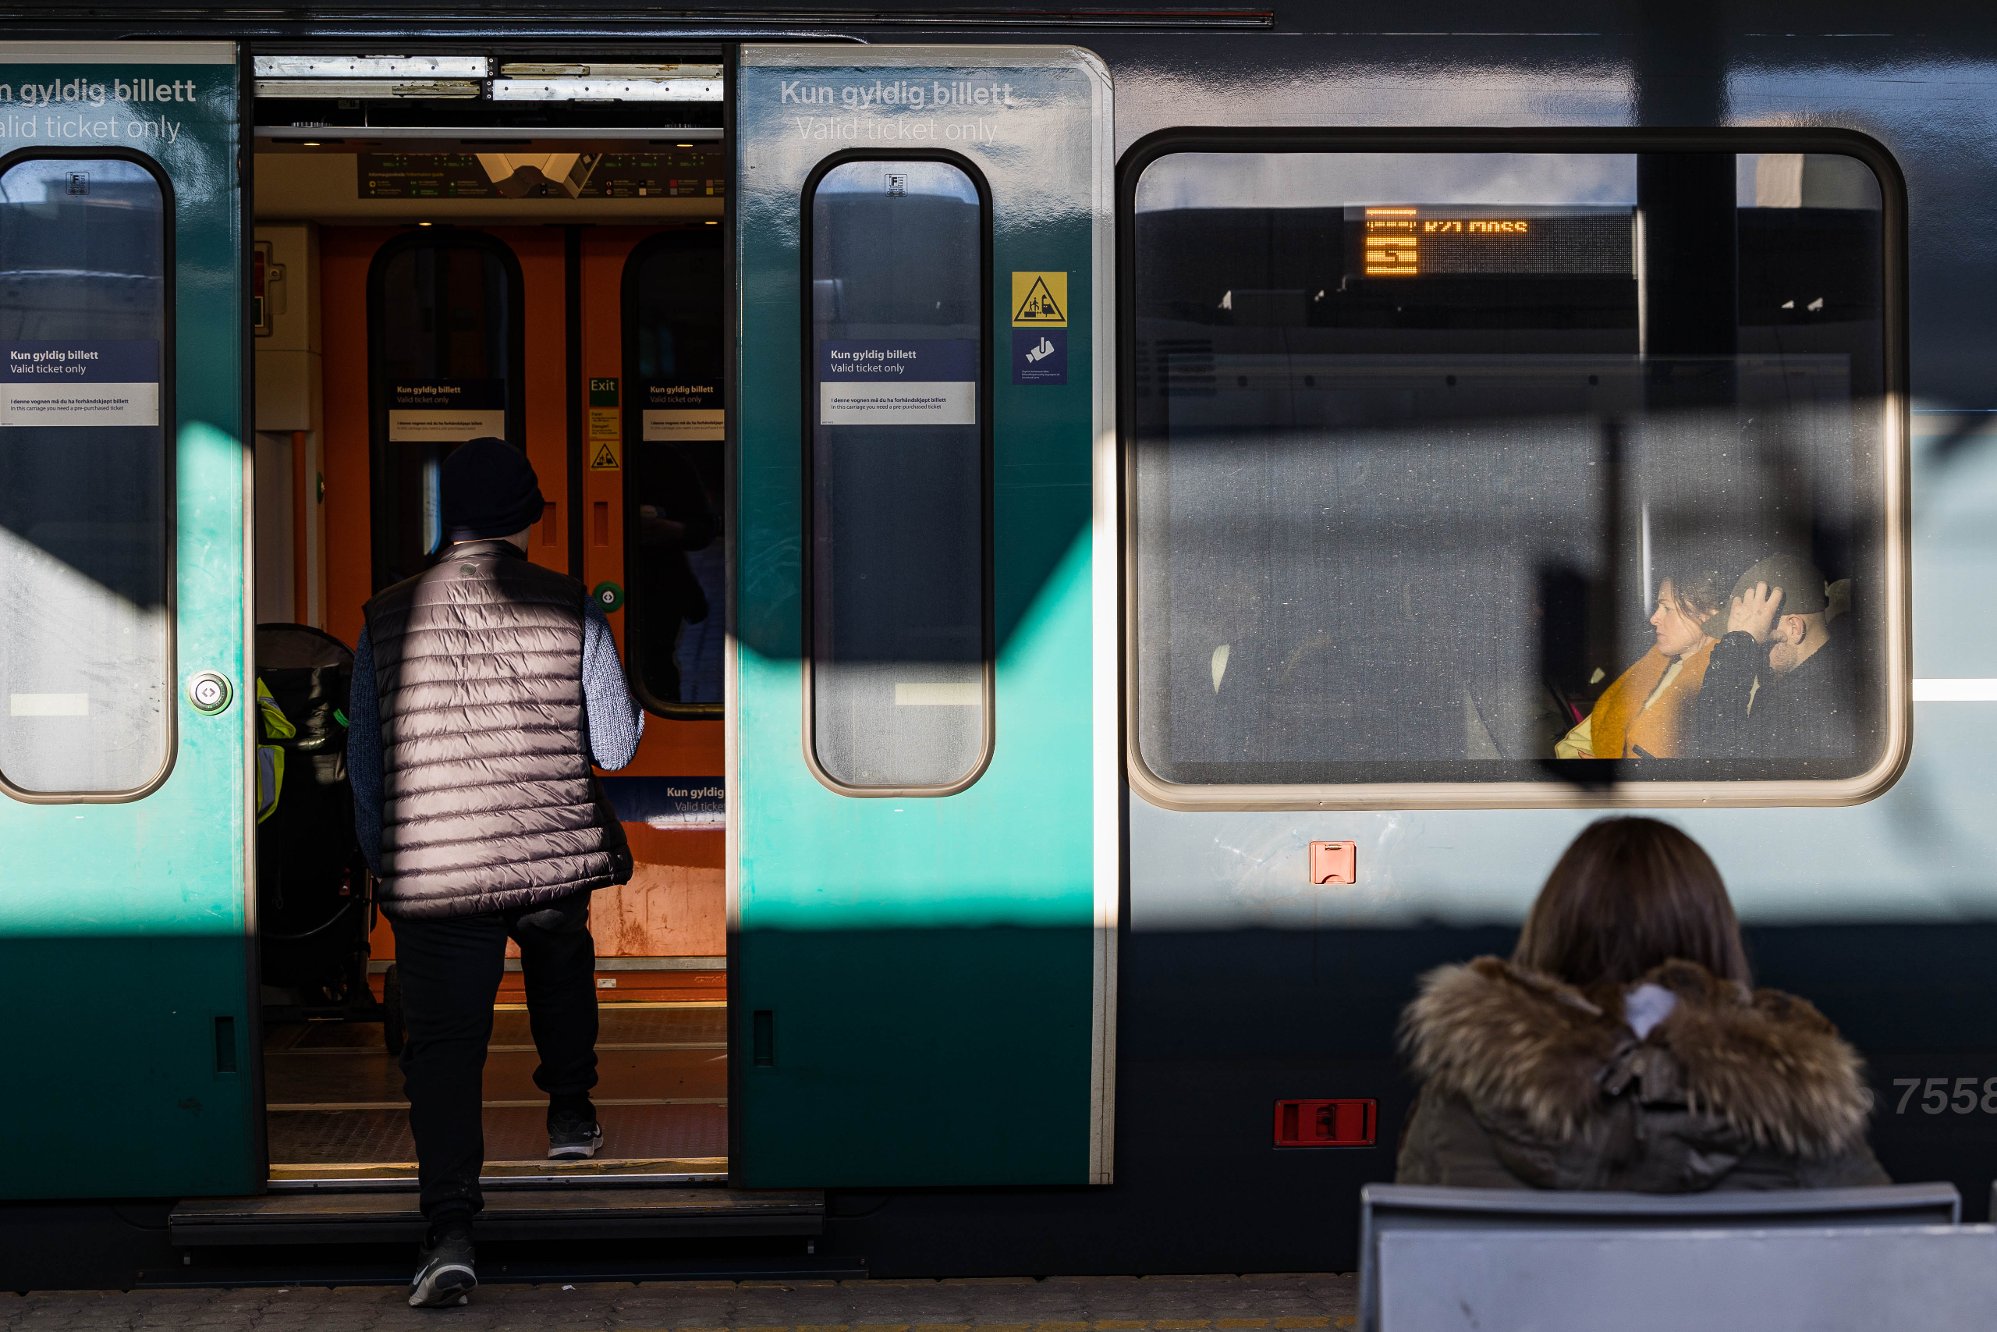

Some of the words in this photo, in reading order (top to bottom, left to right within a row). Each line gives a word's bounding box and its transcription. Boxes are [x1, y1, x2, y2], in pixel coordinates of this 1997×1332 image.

[20, 78, 105, 108] gyldig
[114, 78, 197, 102] billett
[781, 80, 833, 104] Kun
[842, 80, 925, 110] gyldig
[933, 81, 1013, 105] billett
[45, 115, 119, 138] ticket
[127, 115, 181, 144] only
[797, 116, 857, 140] Valid
[867, 116, 938, 140] ticket
[945, 116, 998, 146] only
[10, 350, 31, 360] Kun
[33, 350, 66, 362] gyldig
[67, 350, 99, 360] billett
[831, 350, 851, 359] Kun
[852, 350, 885, 361] gyldig
[886, 350, 917, 359] billett
[10, 364, 34, 374] Valid
[36, 364, 63, 374] ticket
[65, 364, 87, 376] only
[831, 363, 854, 373] Valid
[856, 363, 882, 373] ticket
[884, 363, 905, 375] only
[397, 386, 412, 394] Kun
[413, 386, 437, 395] gyldig
[438, 386, 461, 394] billett
[591, 379, 615, 391] Exit
[666, 386, 690, 395] gyldig
[667, 787, 688, 797] Kun
[690, 787, 725, 798] gyldig
[675, 802, 698, 812] Valid
